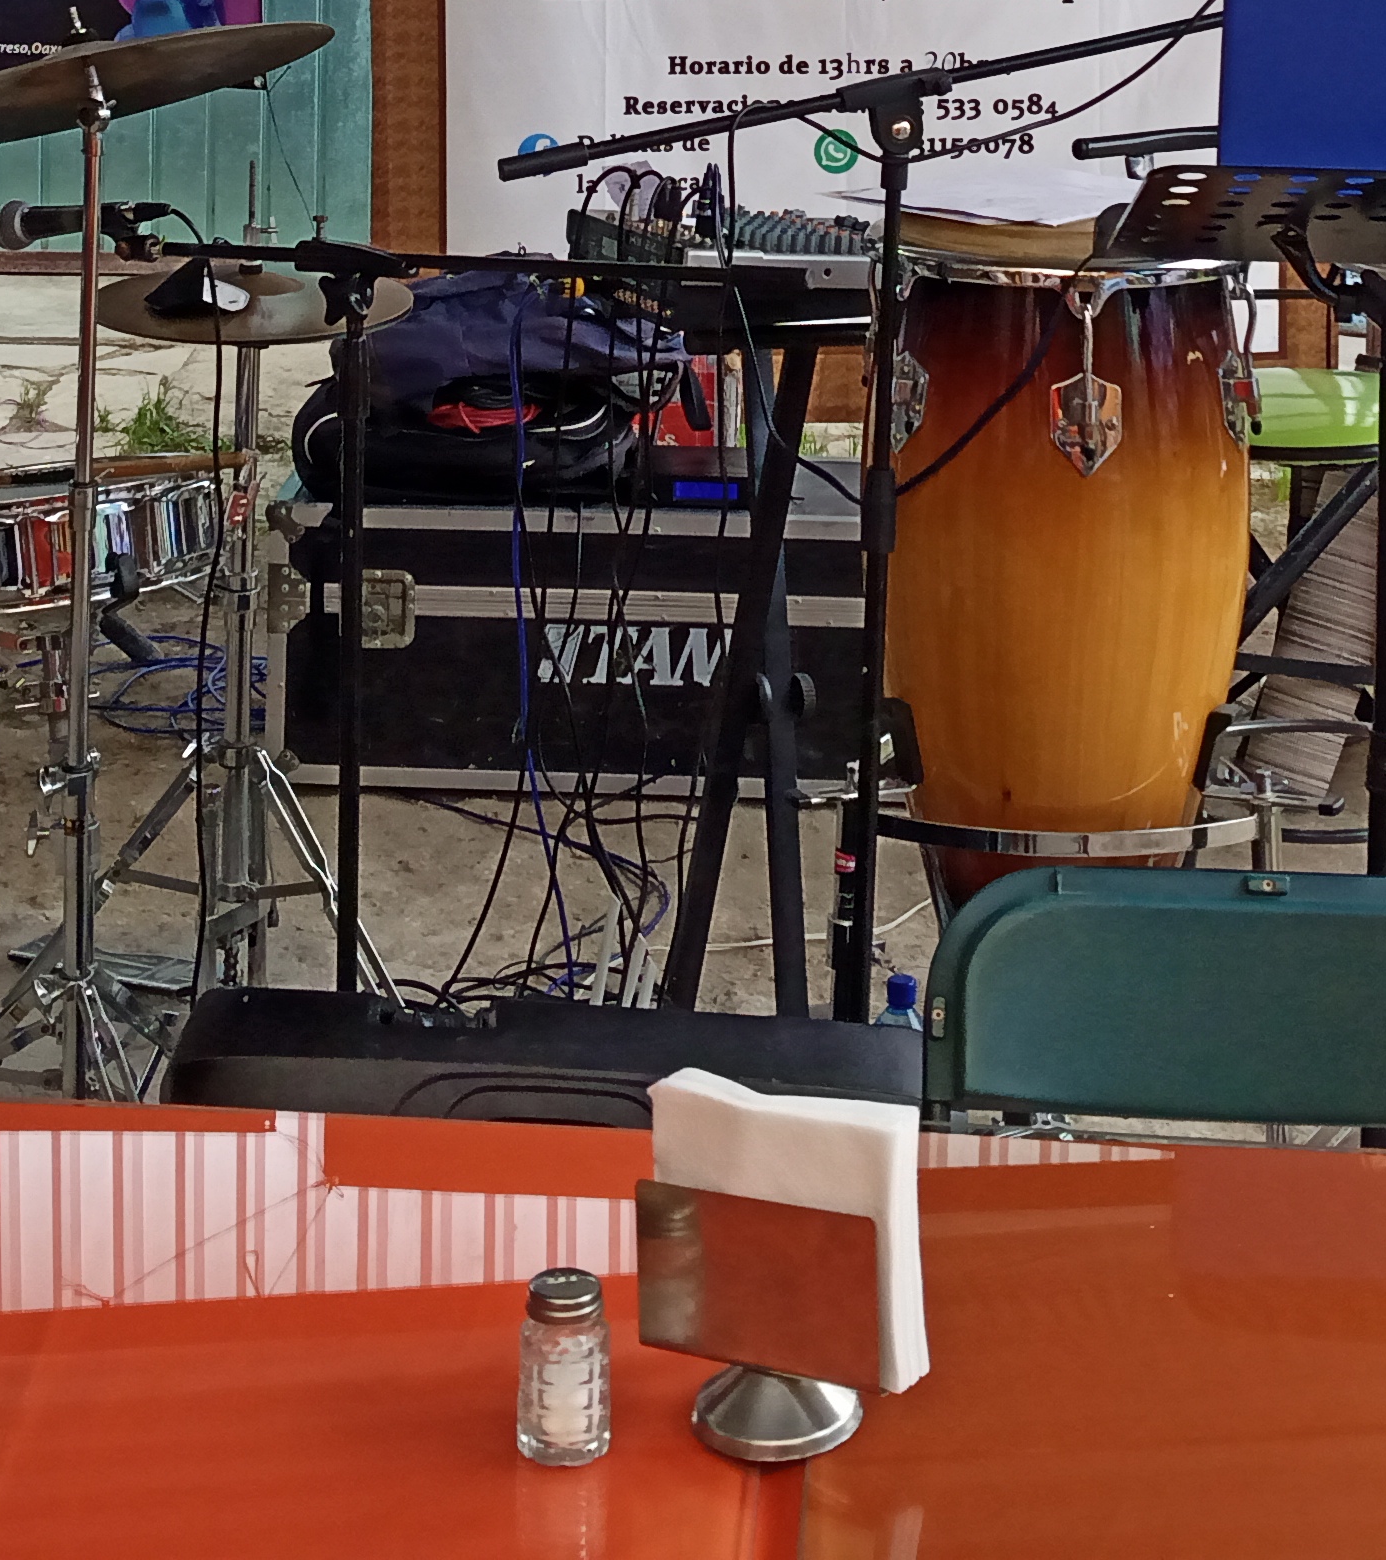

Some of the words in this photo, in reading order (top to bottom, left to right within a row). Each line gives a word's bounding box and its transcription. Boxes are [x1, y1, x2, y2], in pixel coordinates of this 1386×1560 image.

[668, 54, 772, 76] Horario
[778, 54, 810, 75] de
[818, 52, 890, 81] 13hrs
[900, 58, 914, 73] a
[936, 98, 982, 121] 533
[992, 93, 1060, 122] 0584
